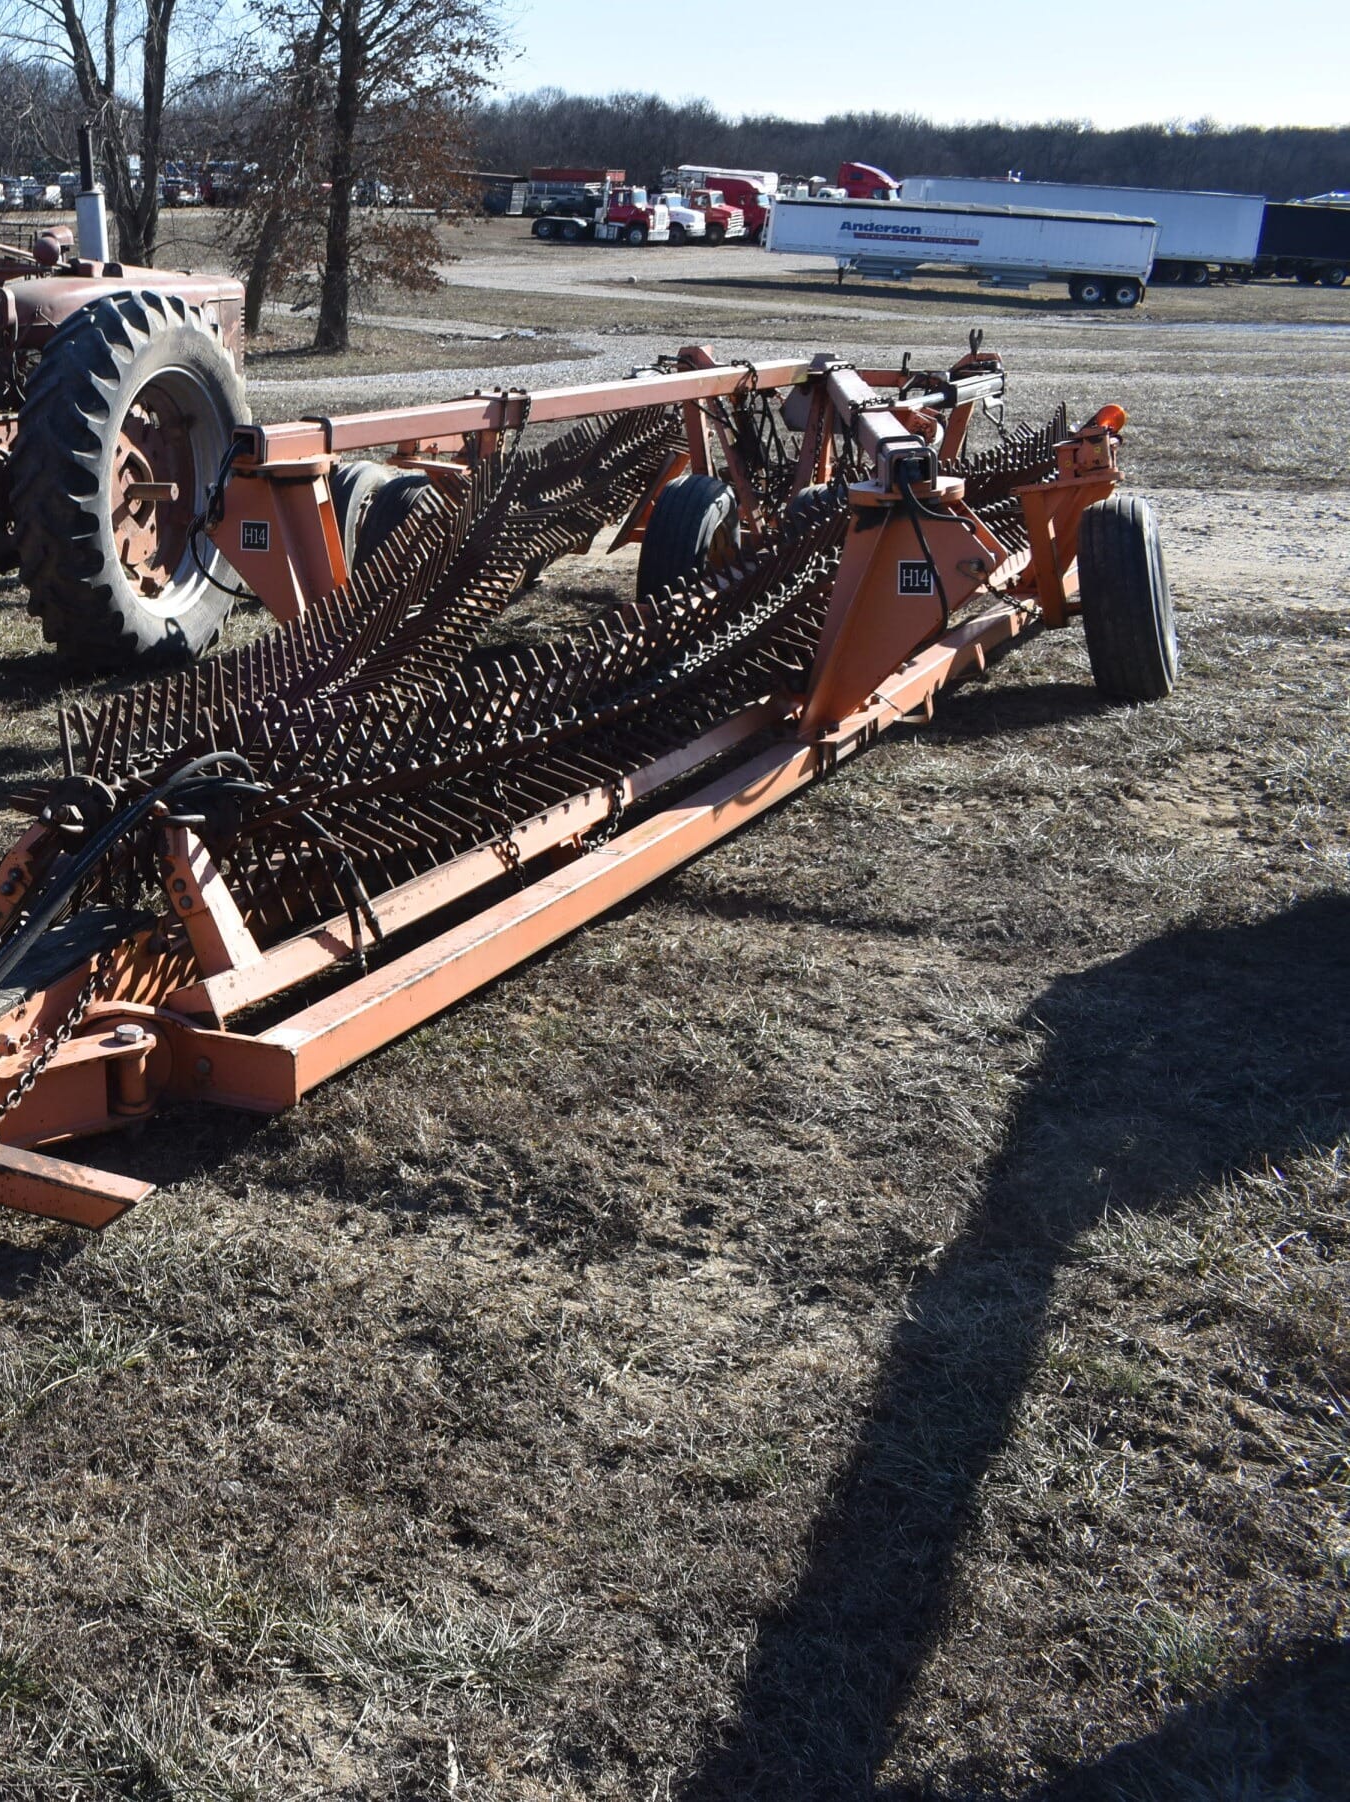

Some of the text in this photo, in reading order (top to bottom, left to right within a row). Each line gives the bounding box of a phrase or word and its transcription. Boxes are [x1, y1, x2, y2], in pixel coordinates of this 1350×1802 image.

[840, 221, 922, 235] Anderson
[243, 527, 267, 545] H14
[902, 568, 930, 587] H14
